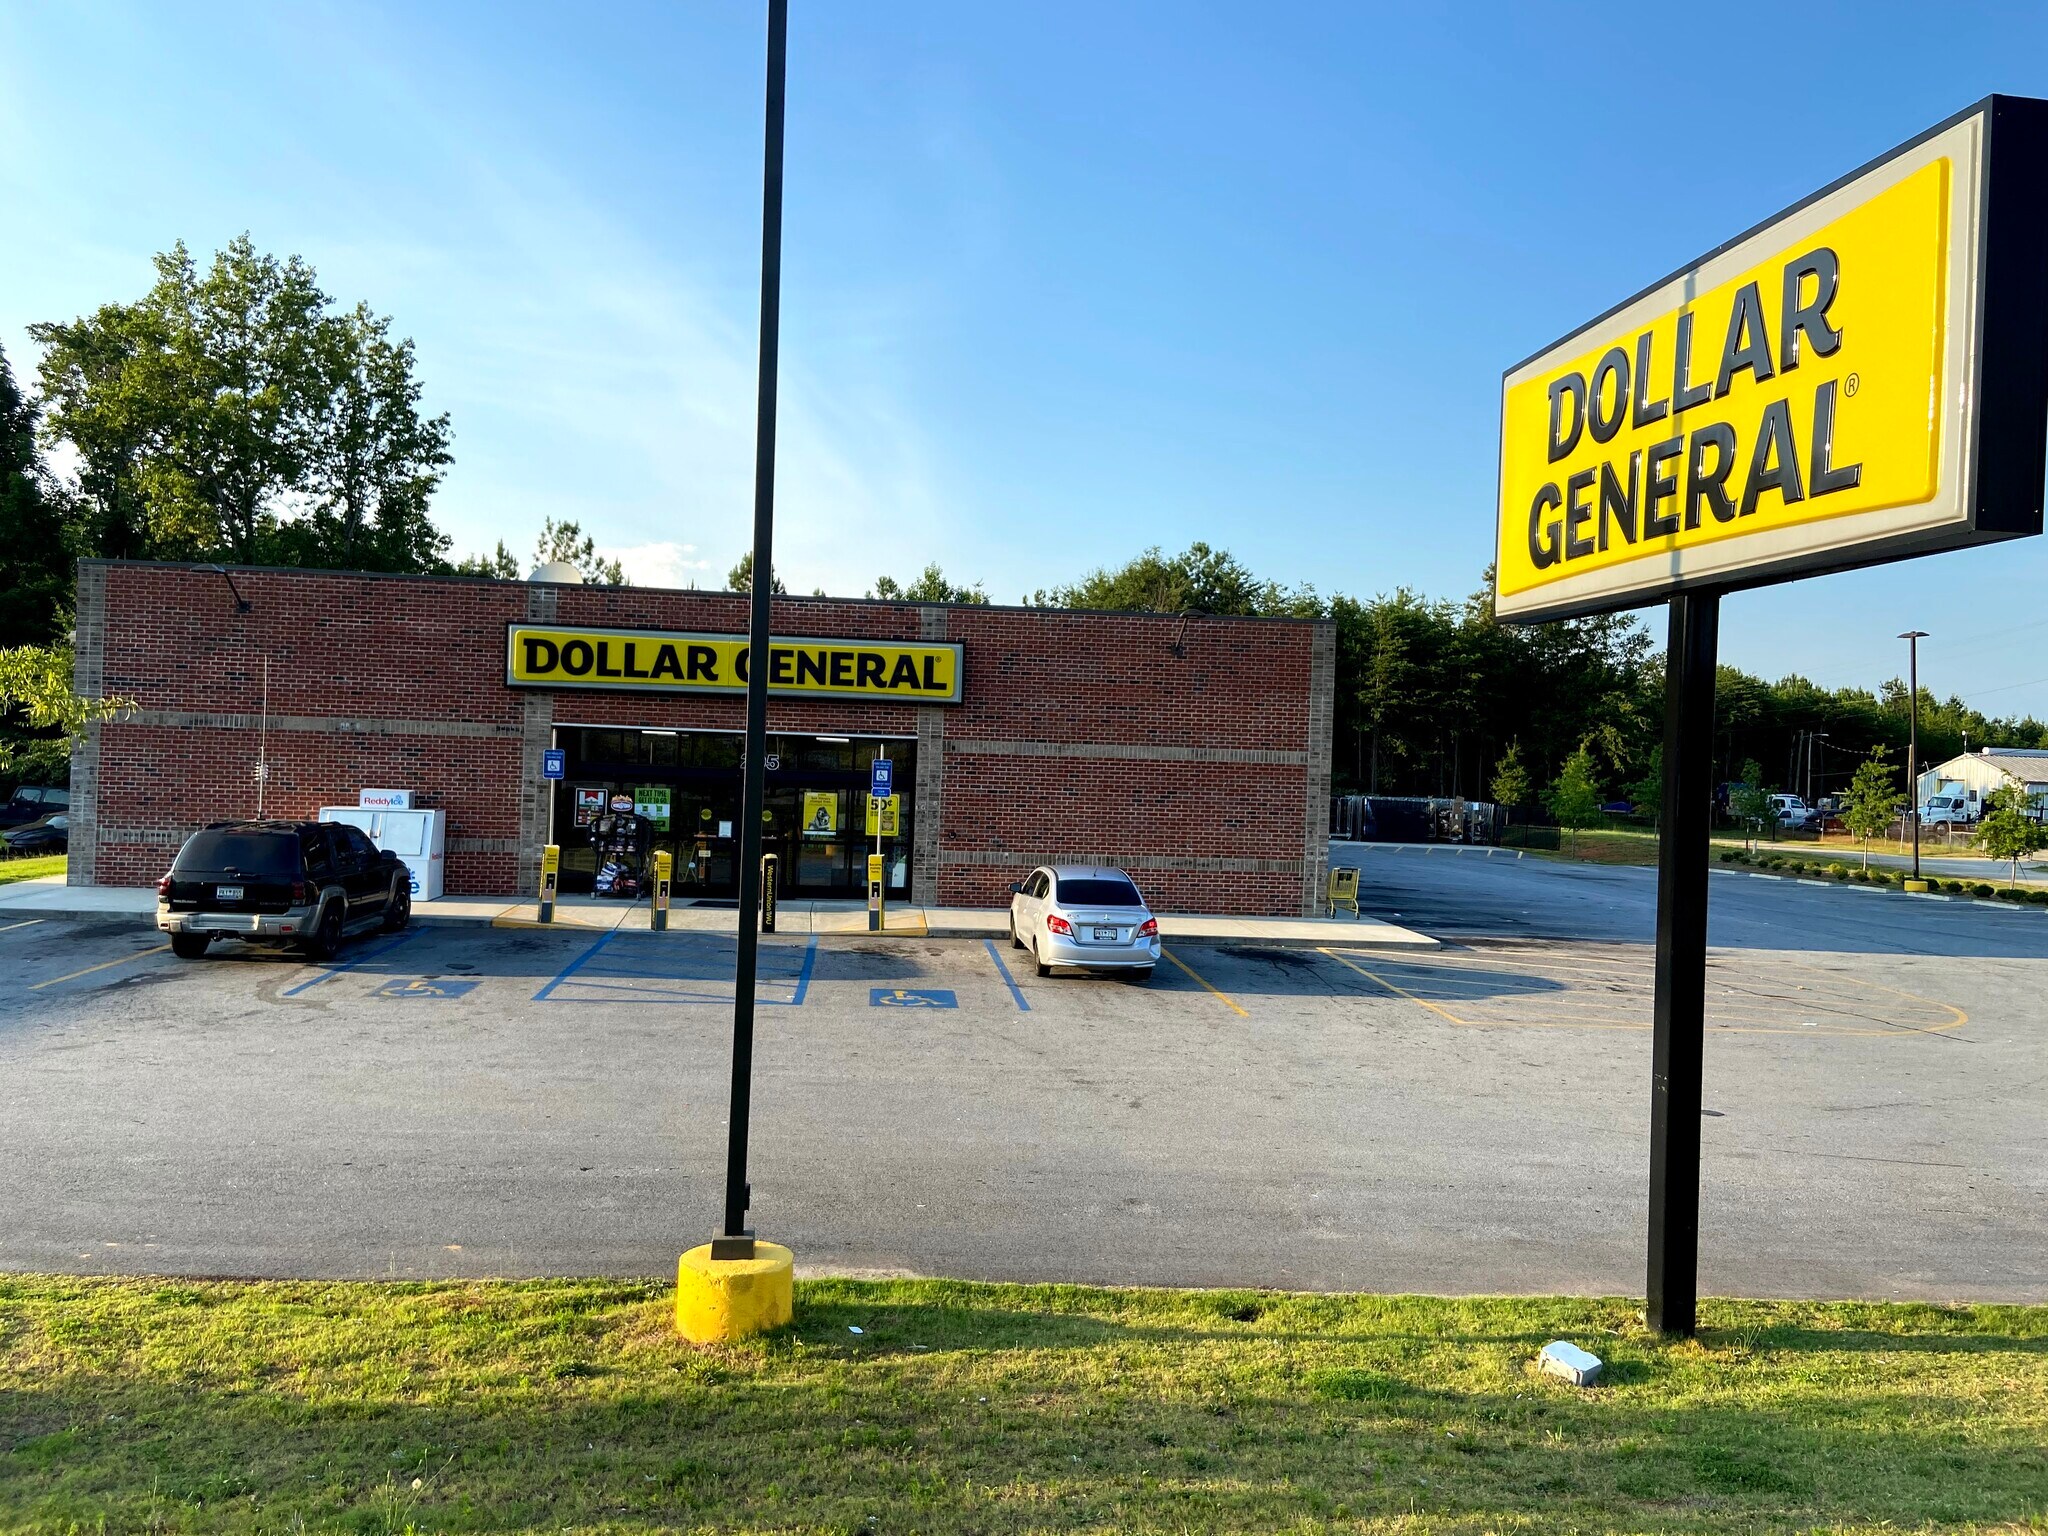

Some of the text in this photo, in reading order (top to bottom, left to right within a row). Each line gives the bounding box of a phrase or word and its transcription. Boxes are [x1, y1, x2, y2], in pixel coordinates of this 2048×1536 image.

[1548, 247, 1843, 464] DOLLAR
[1528, 378, 1862, 570] GENERAL
[523, 638, 719, 682] DOLLAR
[638, 789, 653, 797] NEXT
